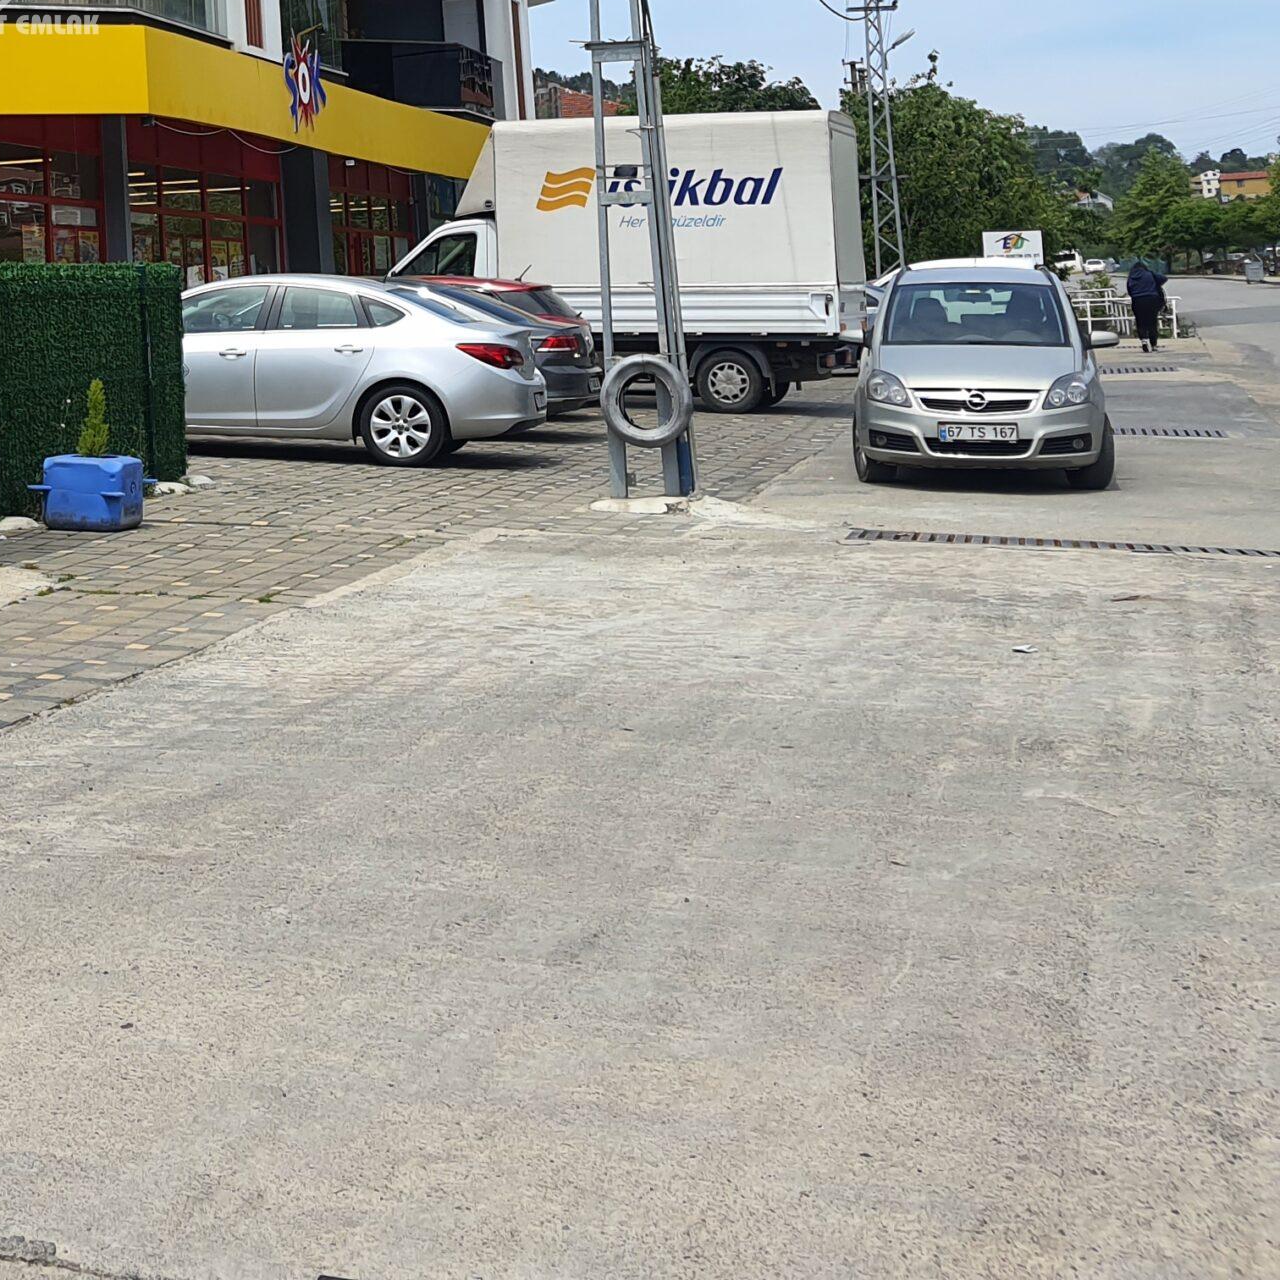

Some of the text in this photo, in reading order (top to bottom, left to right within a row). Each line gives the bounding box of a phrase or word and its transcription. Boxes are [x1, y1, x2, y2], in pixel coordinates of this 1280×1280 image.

[601, 166, 784, 208] sikbal
[619, 215, 646, 229] Her
[947, 426, 1016, 438] 67 TS 167
